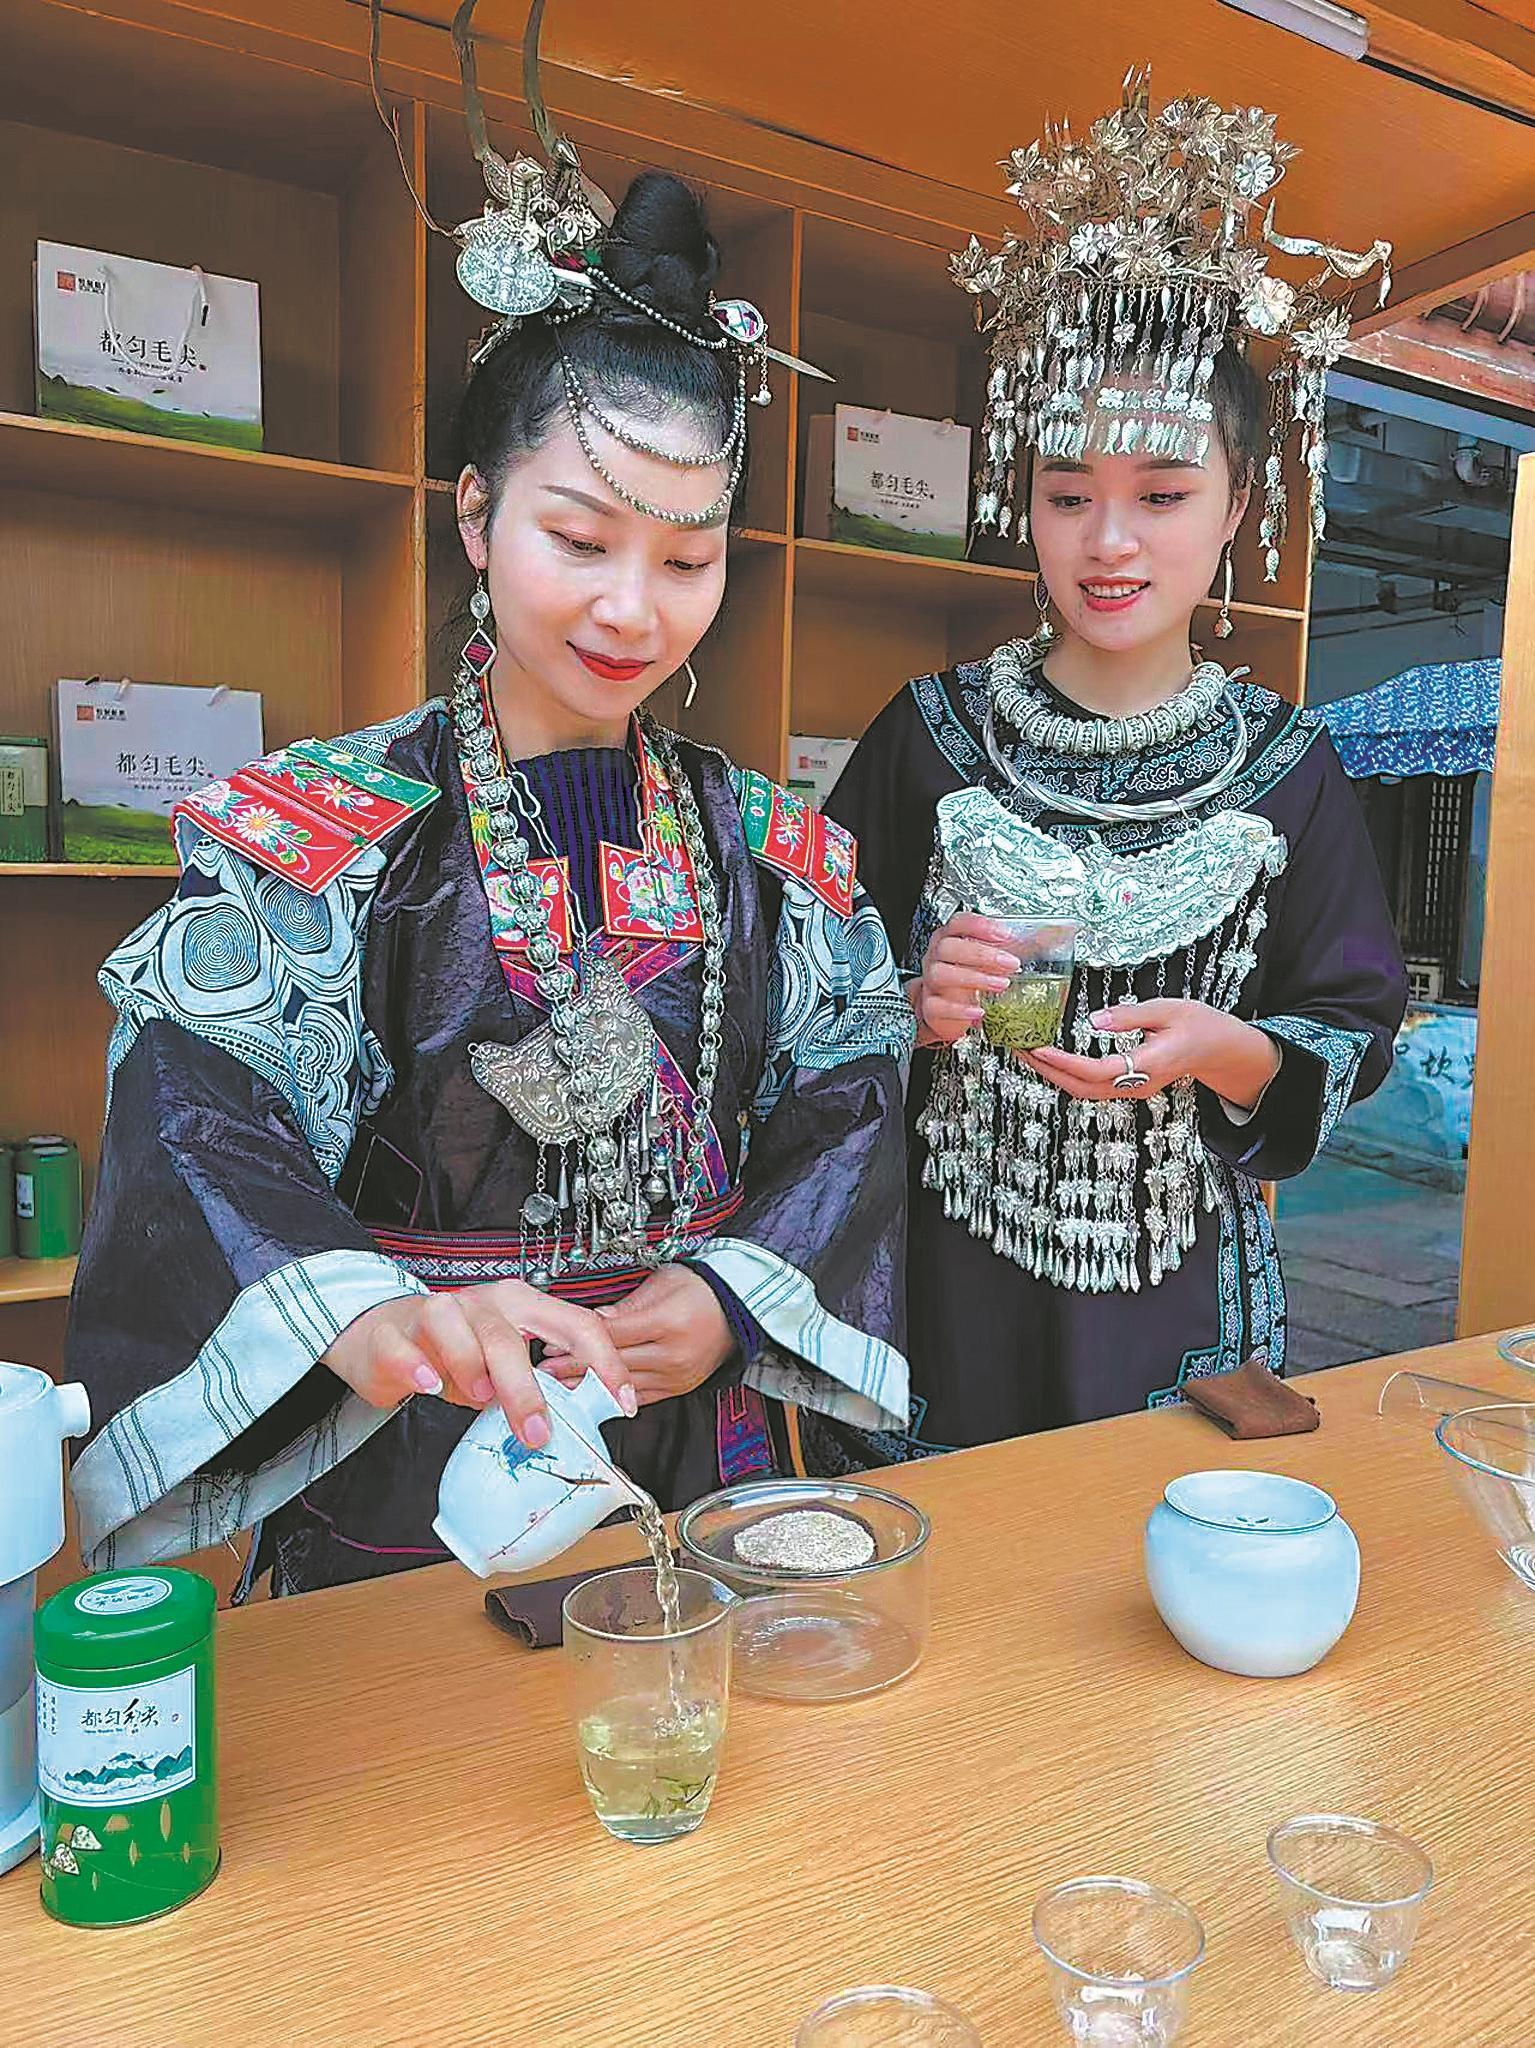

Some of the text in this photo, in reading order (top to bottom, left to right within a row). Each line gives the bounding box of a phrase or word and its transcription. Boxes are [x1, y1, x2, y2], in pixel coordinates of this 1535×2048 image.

[99, 330, 197, 368] 都匀毛尖
[871, 471, 930, 499] 都匀毛尖
[117, 752, 206, 777] 都匀毛尖
